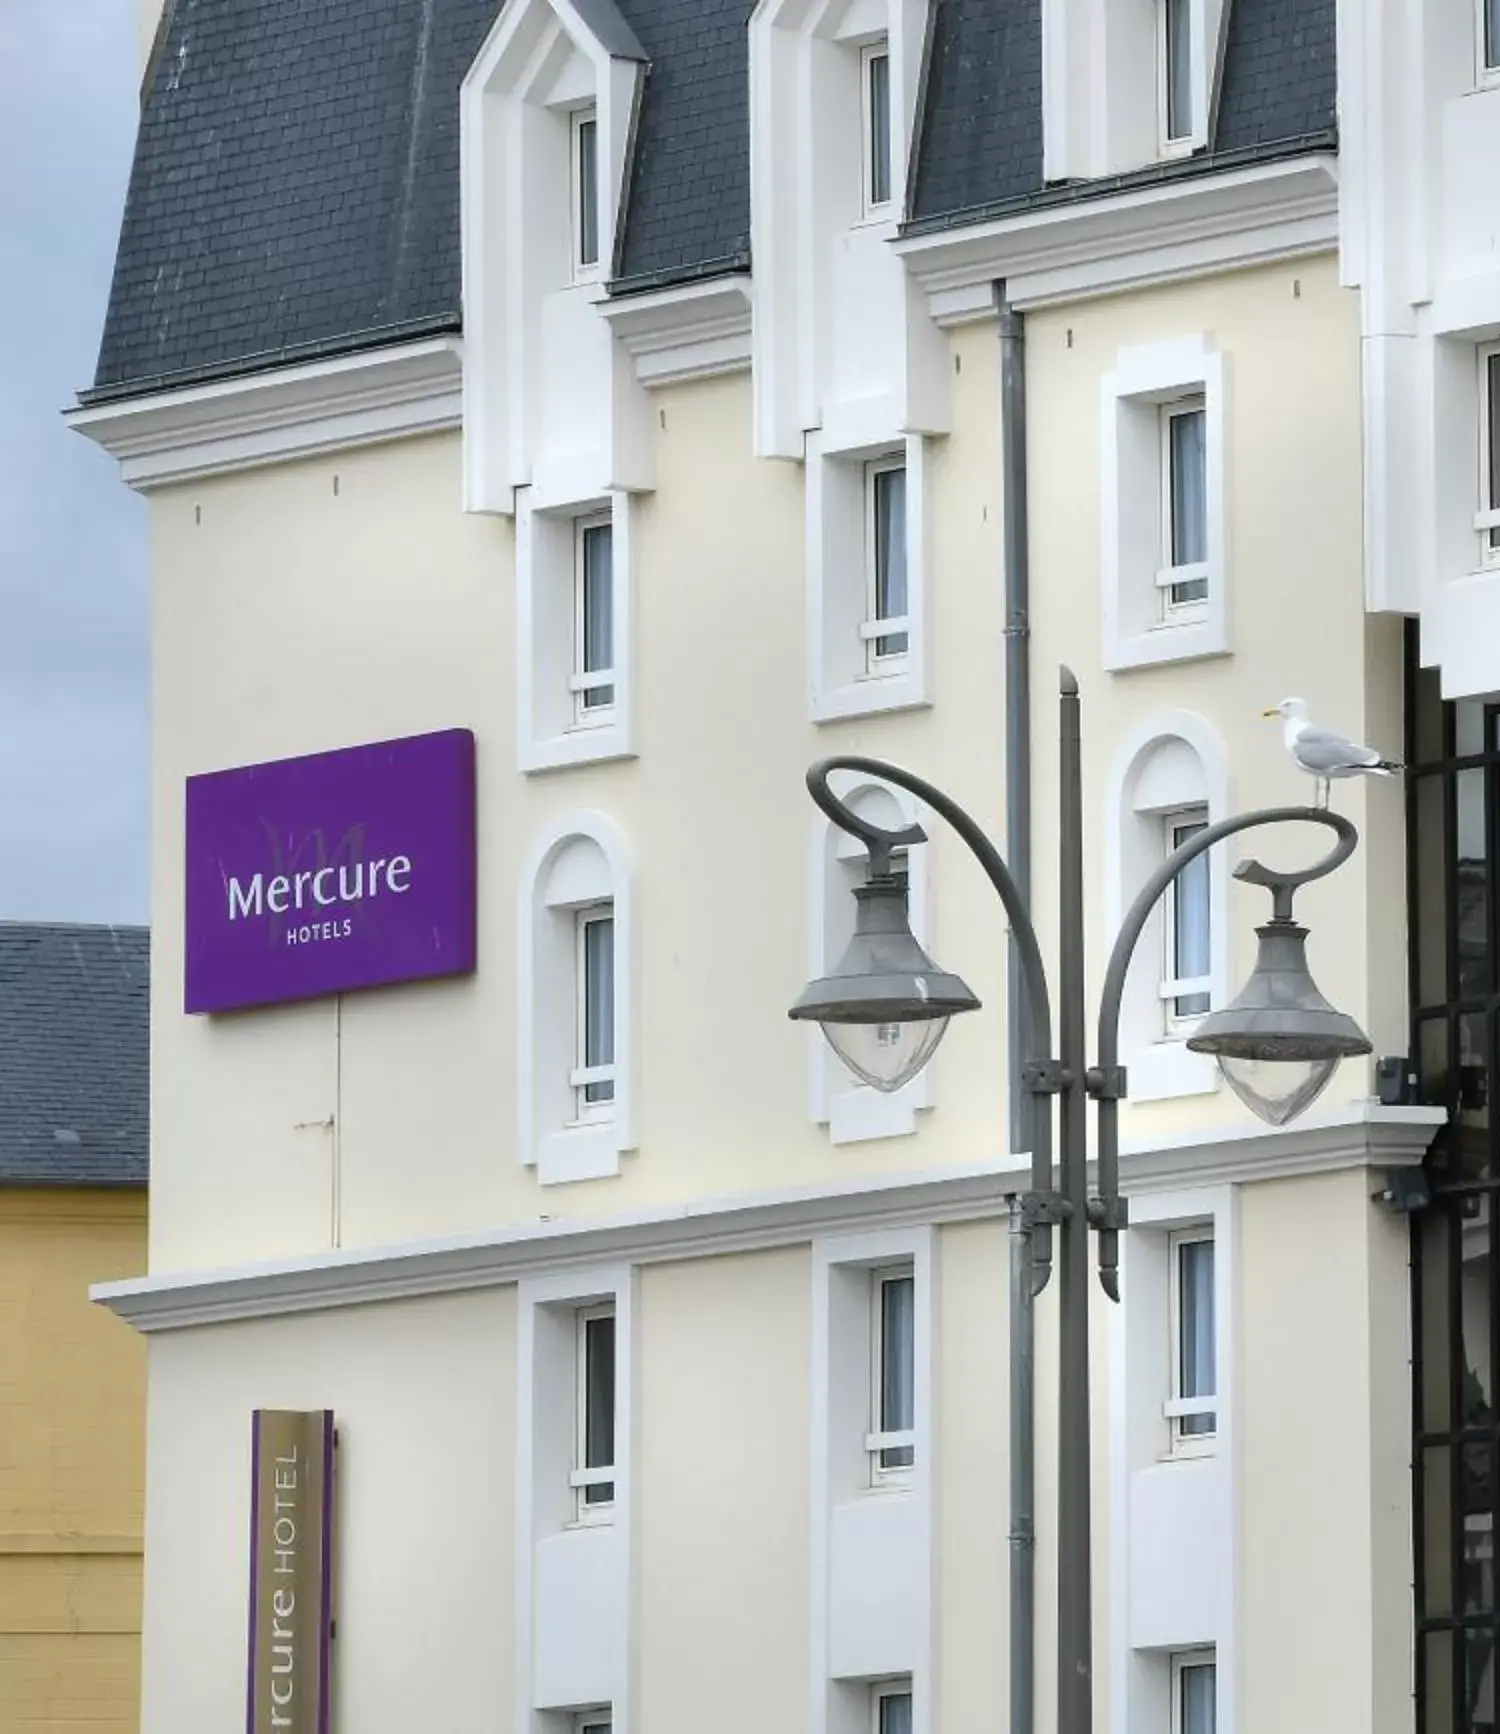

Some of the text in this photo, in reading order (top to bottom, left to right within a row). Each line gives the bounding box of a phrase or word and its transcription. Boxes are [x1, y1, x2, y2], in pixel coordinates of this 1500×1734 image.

[228, 855, 411, 920] Mercure
[286, 918, 352, 945] HOTELS
[271, 1445, 297, 1734] rcure HOTEL
